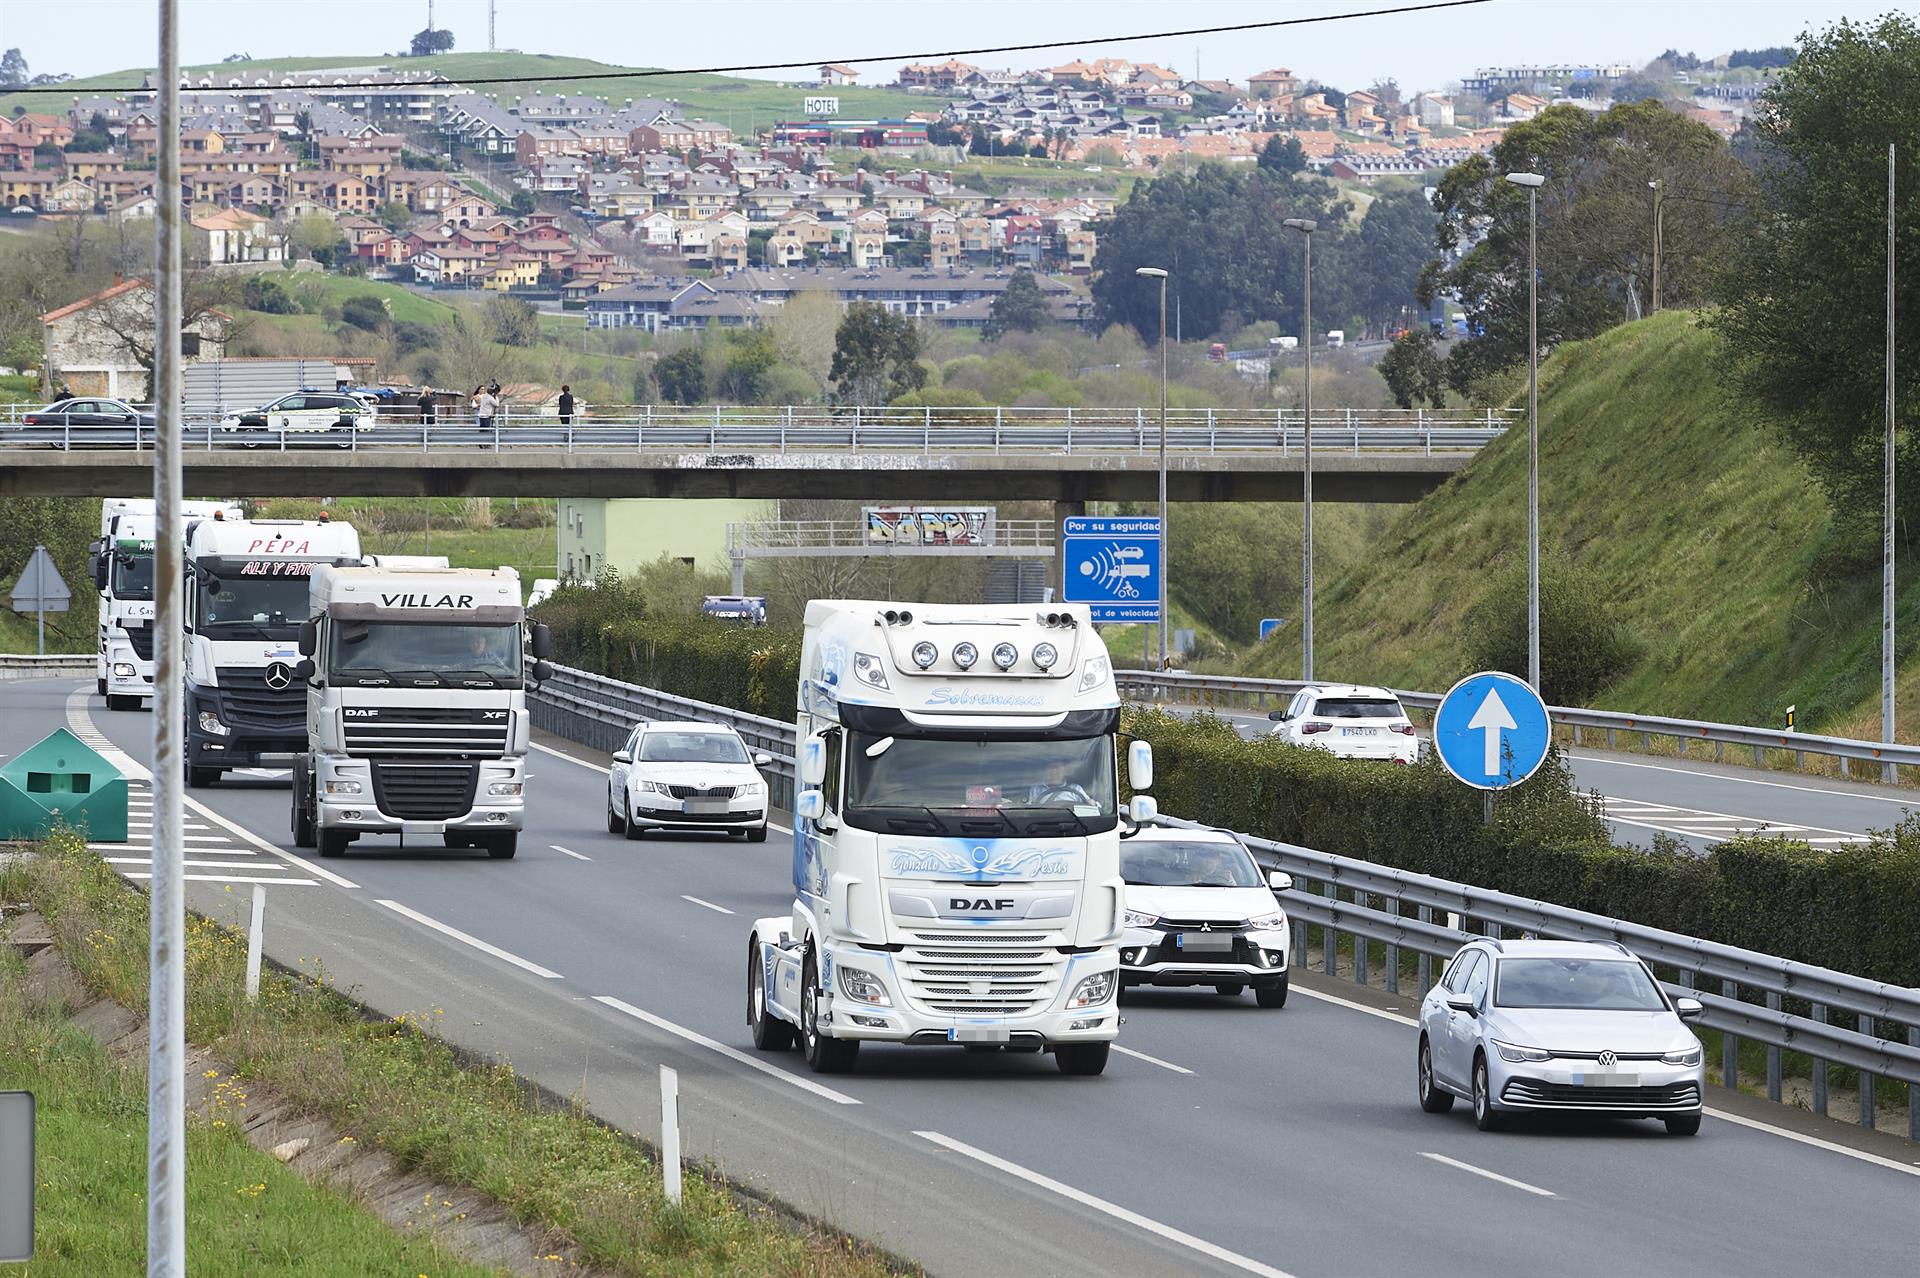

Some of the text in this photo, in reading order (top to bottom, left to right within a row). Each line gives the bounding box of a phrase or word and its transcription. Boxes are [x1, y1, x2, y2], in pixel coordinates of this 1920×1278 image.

[806, 99, 836, 112] HOTEL
[1068, 520, 1160, 533] Por su seguridad
[248, 539, 310, 554] PEPA
[240, 561, 271, 575] ALI
[272, 561, 285, 576] Y
[381, 593, 474, 608] VILLAR
[1105, 609, 1116, 617] de
[1120, 608, 1160, 617] velocidad
[345, 709, 379, 717] DAF
[482, 711, 507, 719] XF
[950, 898, 1014, 910] DAF
